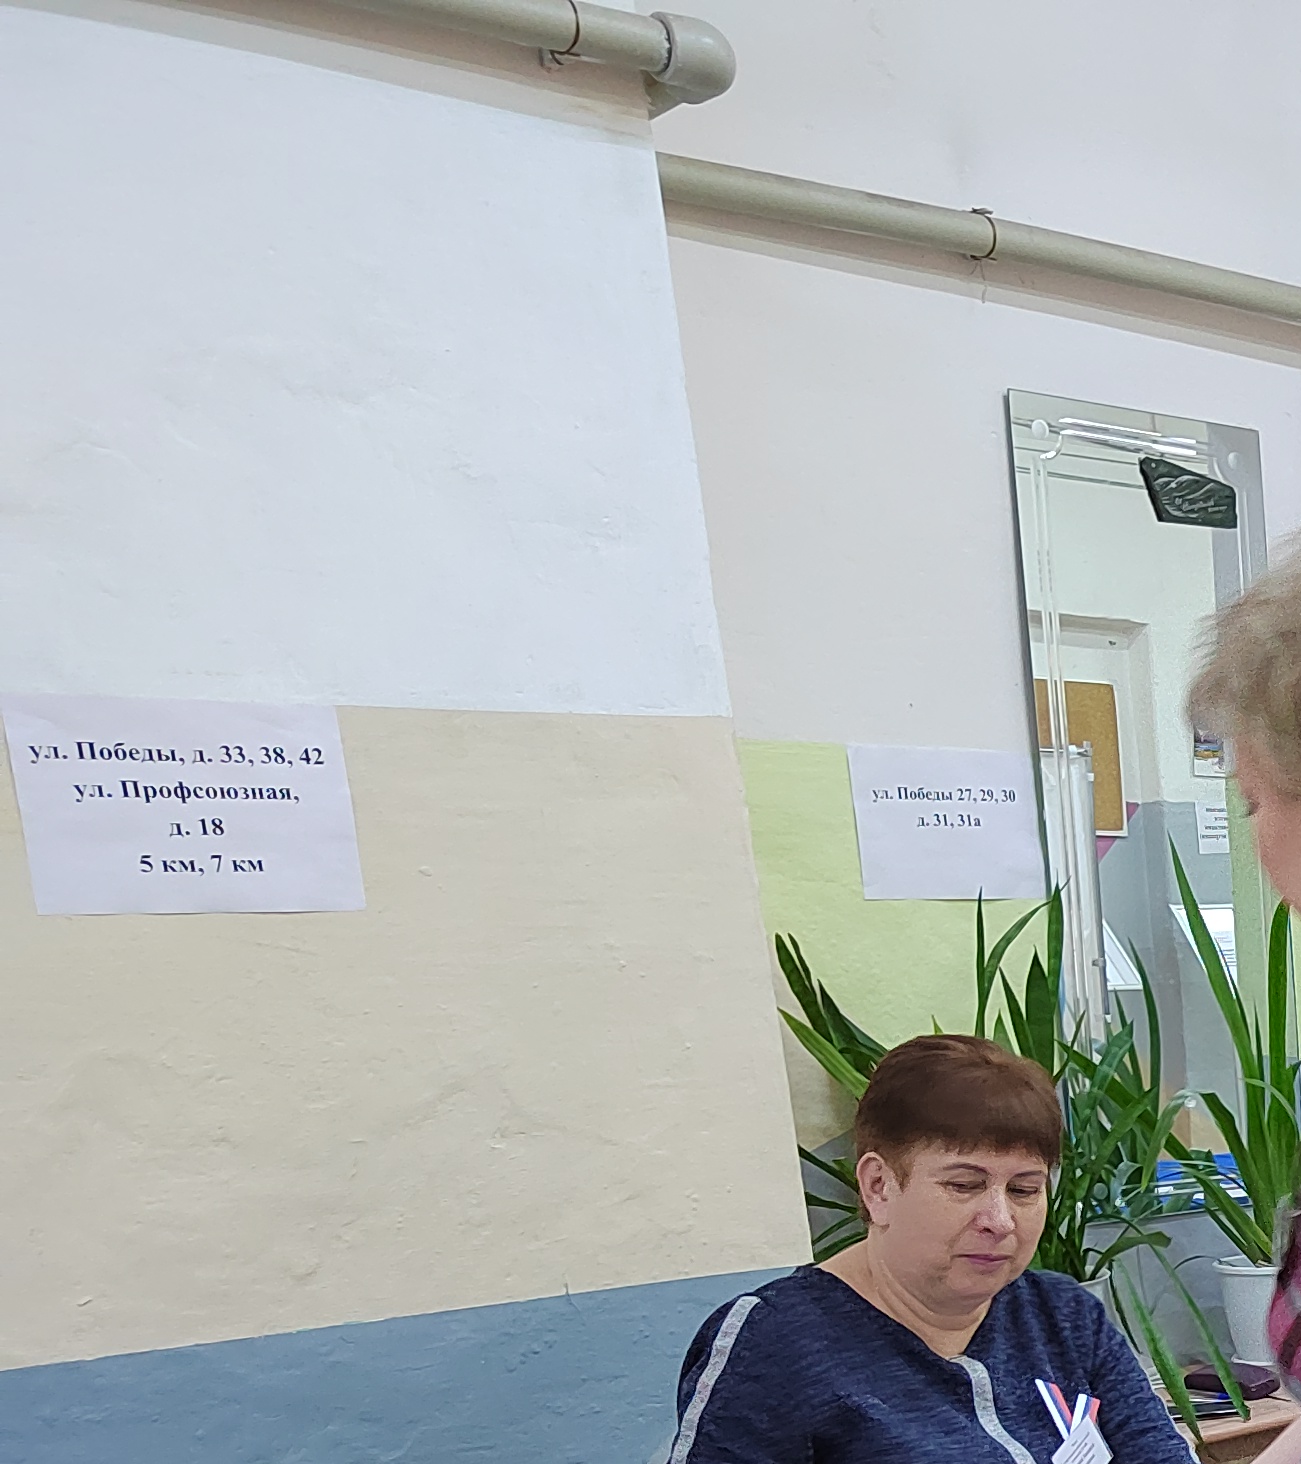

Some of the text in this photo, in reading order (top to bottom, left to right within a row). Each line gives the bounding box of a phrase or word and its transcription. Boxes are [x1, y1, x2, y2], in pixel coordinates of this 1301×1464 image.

[28, 741, 325, 768] ул. Победы, д. 33, 38, 42
[73, 780, 300, 804] ул. Профсоюзная,
[872, 787, 1016, 804] ул. Победы 27, 29, 30
[169, 818, 225, 837] д. 18
[917, 814, 981, 828] д. 31, 31а
[140, 855, 264, 876] 5 км, 7 км
